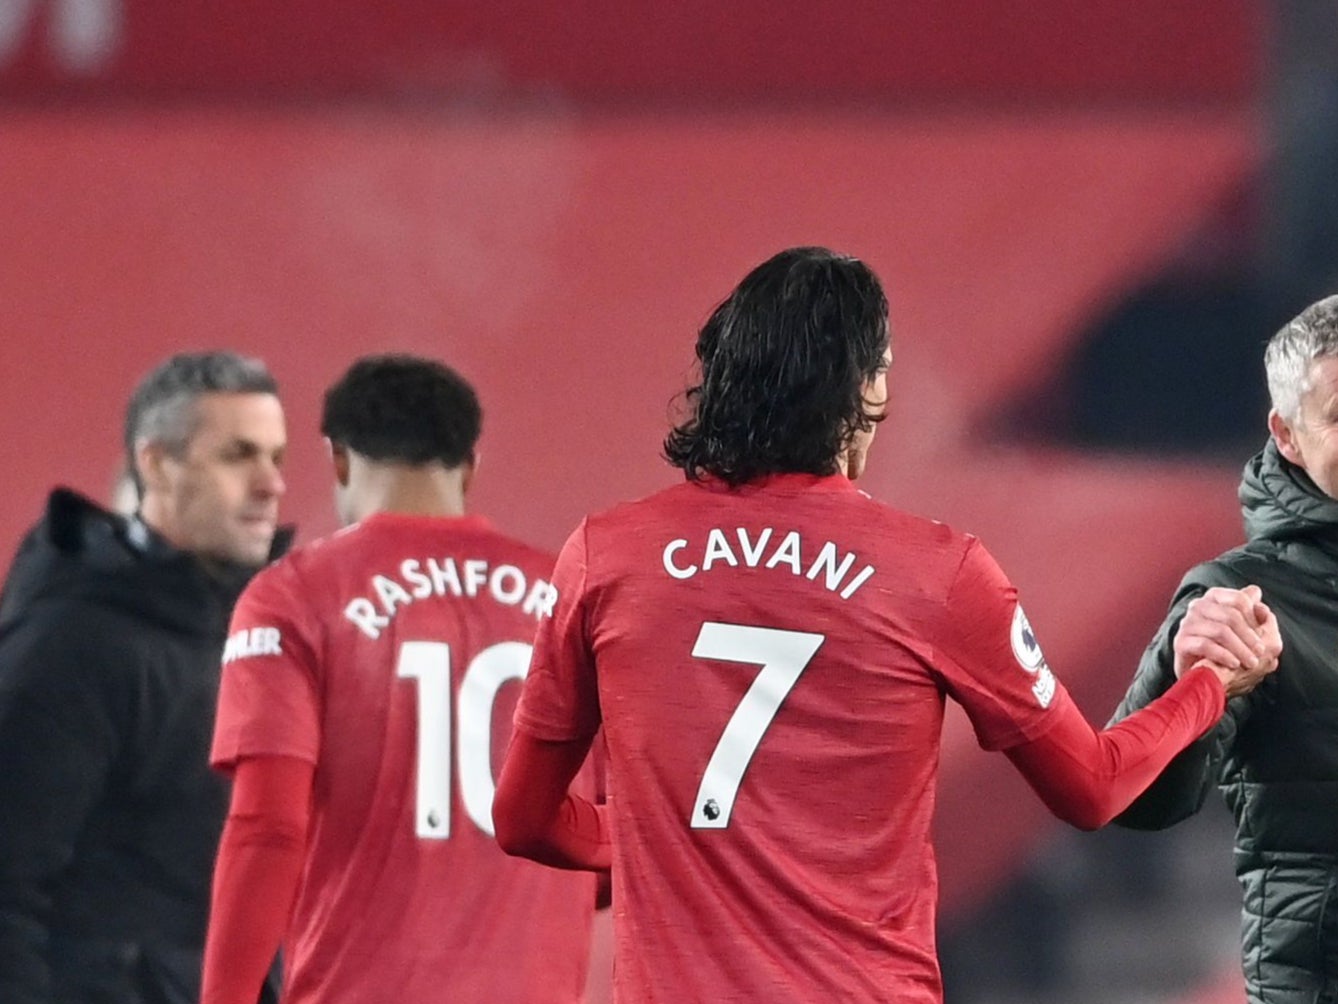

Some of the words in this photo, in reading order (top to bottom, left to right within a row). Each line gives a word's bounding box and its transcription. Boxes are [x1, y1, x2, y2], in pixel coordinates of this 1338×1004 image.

[343, 557, 557, 640] RASHFOR
[662, 527, 875, 600] CAVANI
[397, 640, 534, 840] 10
[690, 621, 825, 828] 7
